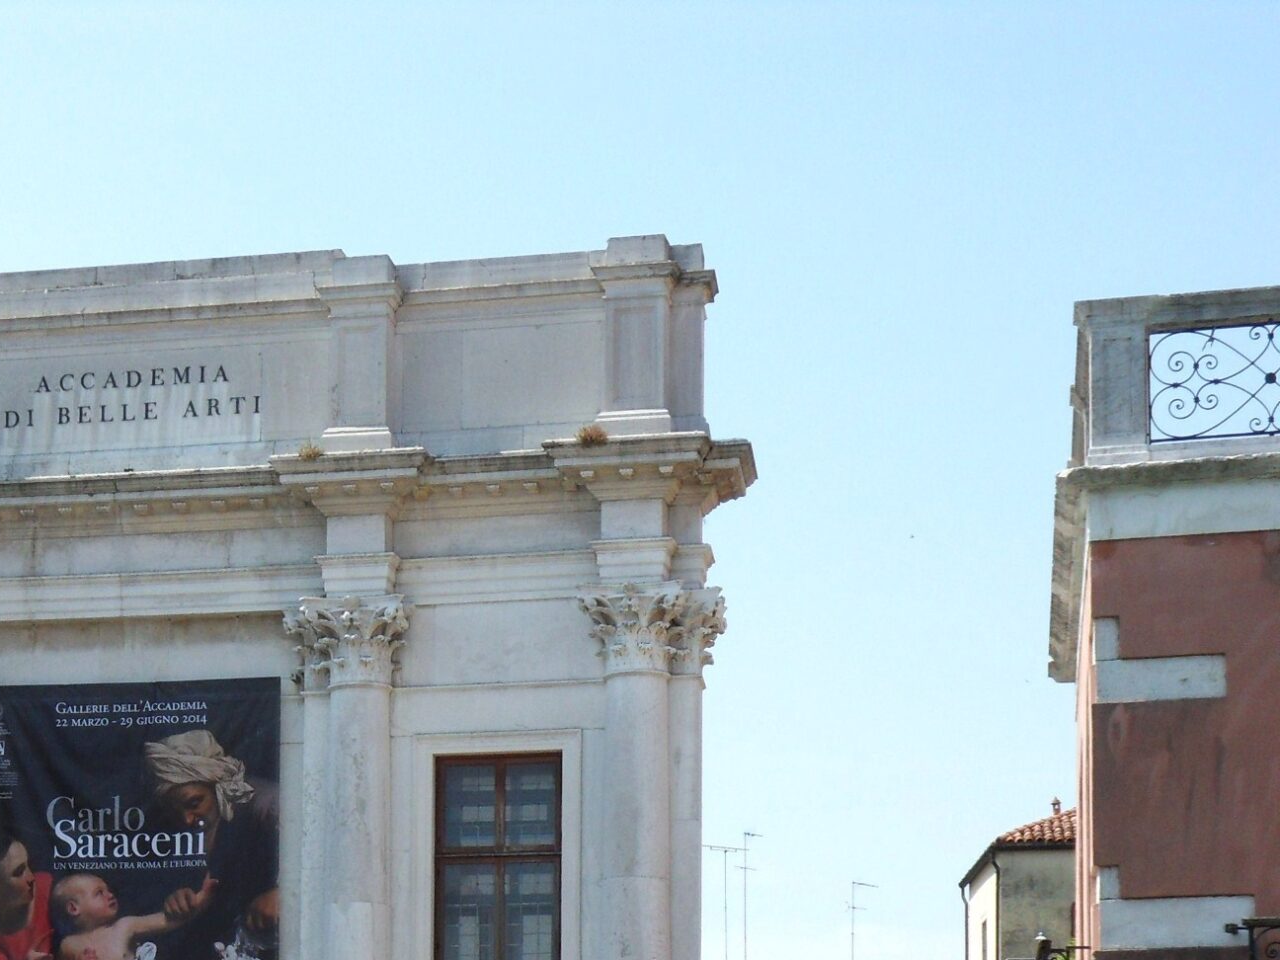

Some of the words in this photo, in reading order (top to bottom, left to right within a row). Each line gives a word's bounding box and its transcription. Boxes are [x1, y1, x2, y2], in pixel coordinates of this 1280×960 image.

[35, 365, 229, 393] ACCADEMIA
[5, 409, 35, 428] DI
[57, 402, 158, 425] BELLE
[182, 395, 261, 418] ARTI
[55, 702, 110, 714] GALLERIE
[113, 700, 208, 713] DELL'ACCADEMIA
[56, 718, 68, 728] 22
[71, 717, 109, 727] MARZO
[120, 717, 133, 728] 29
[136, 715, 179, 726] GIUGNO
[182, 715, 208, 725] 2014
[46, 795, 145, 832] Carlo
[53, 819, 208, 858] Saraceni
[53, 862, 66, 870] UN
[68, 861, 118, 870] VENEZIANO
[120, 861, 135, 869] TRA
[136, 861, 161, 869] ROMA
[169, 859, 208, 868] L'EUROPA
